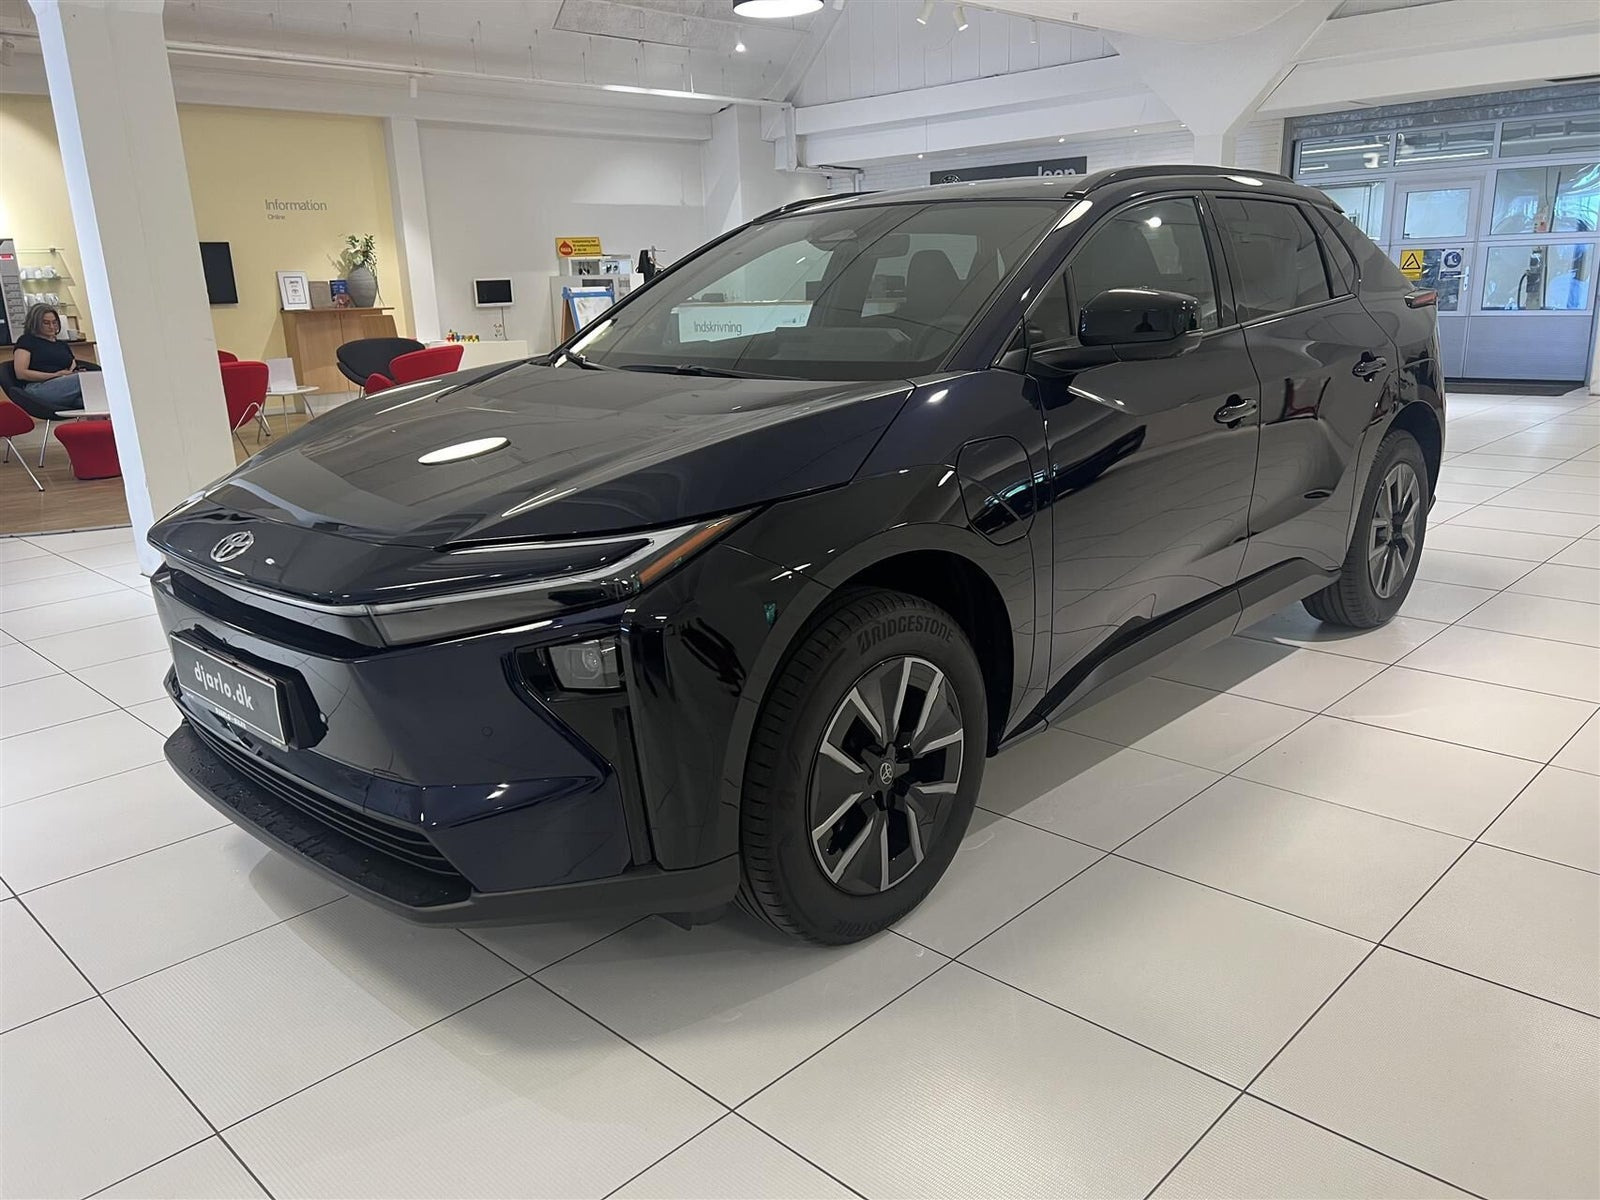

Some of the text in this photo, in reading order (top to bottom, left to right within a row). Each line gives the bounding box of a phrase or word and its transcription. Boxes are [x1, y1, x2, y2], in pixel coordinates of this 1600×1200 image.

[265, 199, 327, 210] Information
[694, 321, 742, 335] Indskrivning
[857, 615, 953, 655] BRIDGESTONE
[194, 661, 254, 710] djarlo.dk
